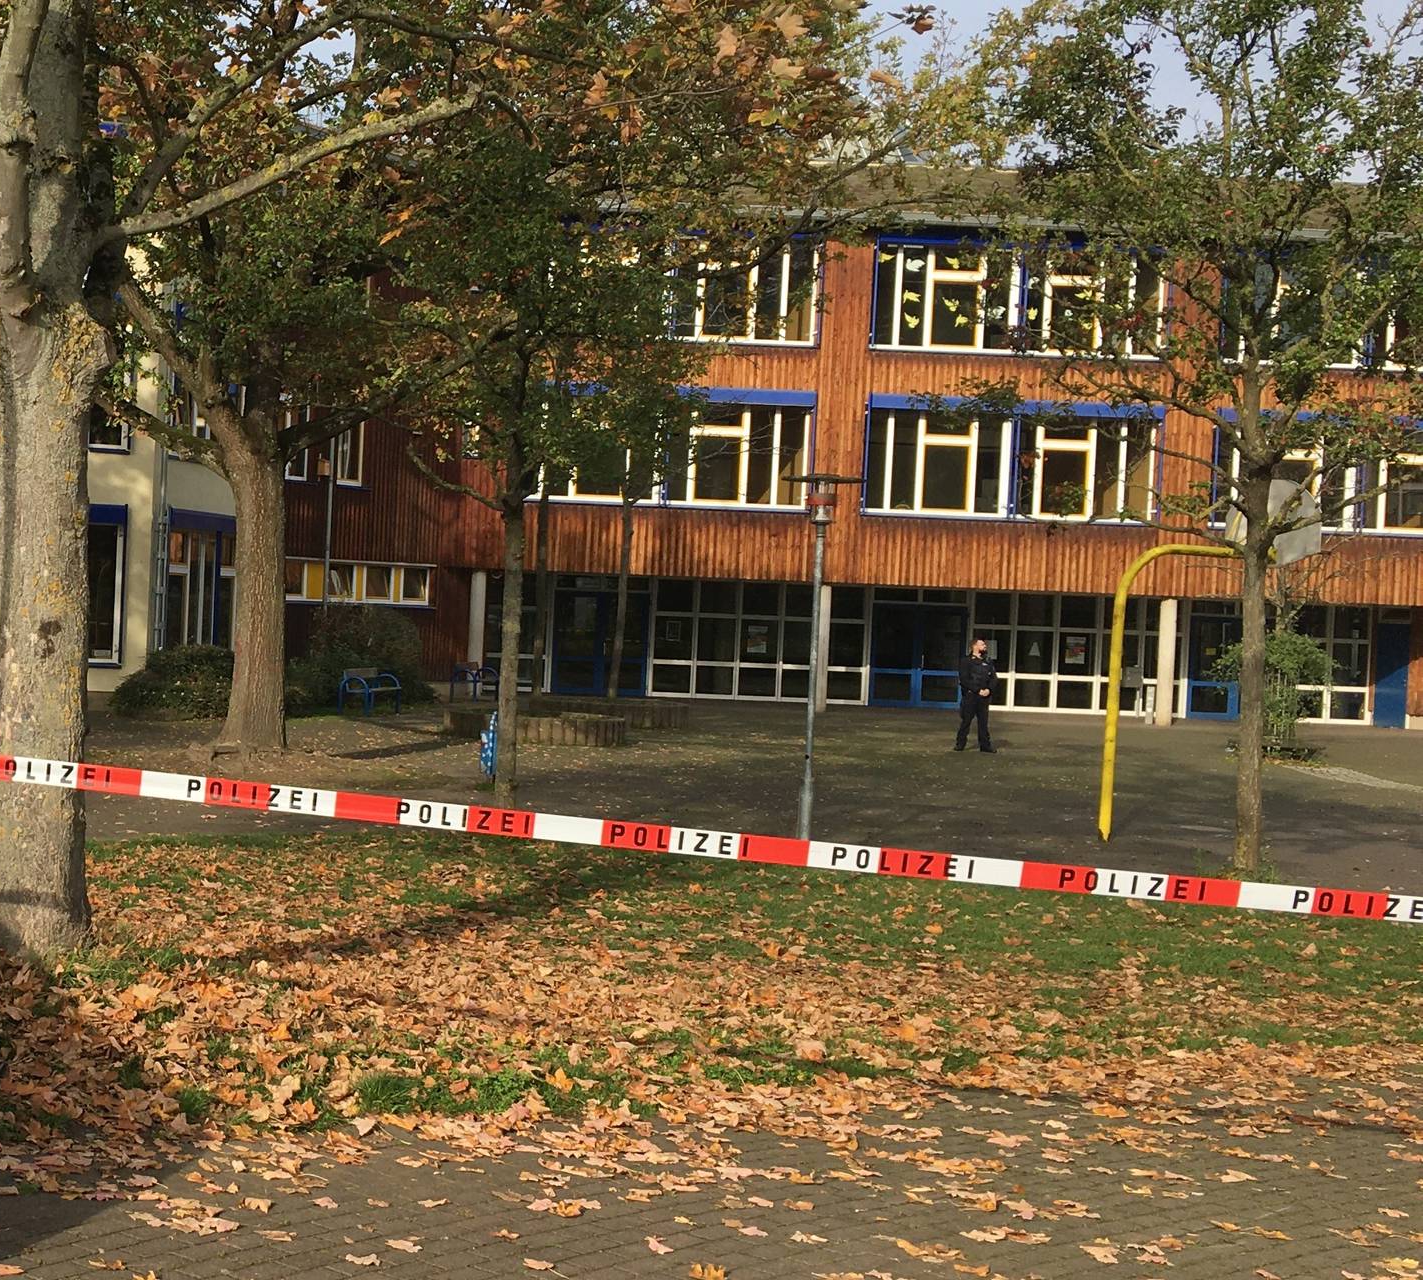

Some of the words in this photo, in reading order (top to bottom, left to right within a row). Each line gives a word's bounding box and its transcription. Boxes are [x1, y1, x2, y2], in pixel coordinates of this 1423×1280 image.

[187, 779, 318, 812] POLIZEI
[396, 801, 531, 836] POLIZEI
[609, 824, 750, 858] POLIZEI
[831, 846, 975, 879] POLIZEI
[1058, 868, 1207, 901] POLIZEI
